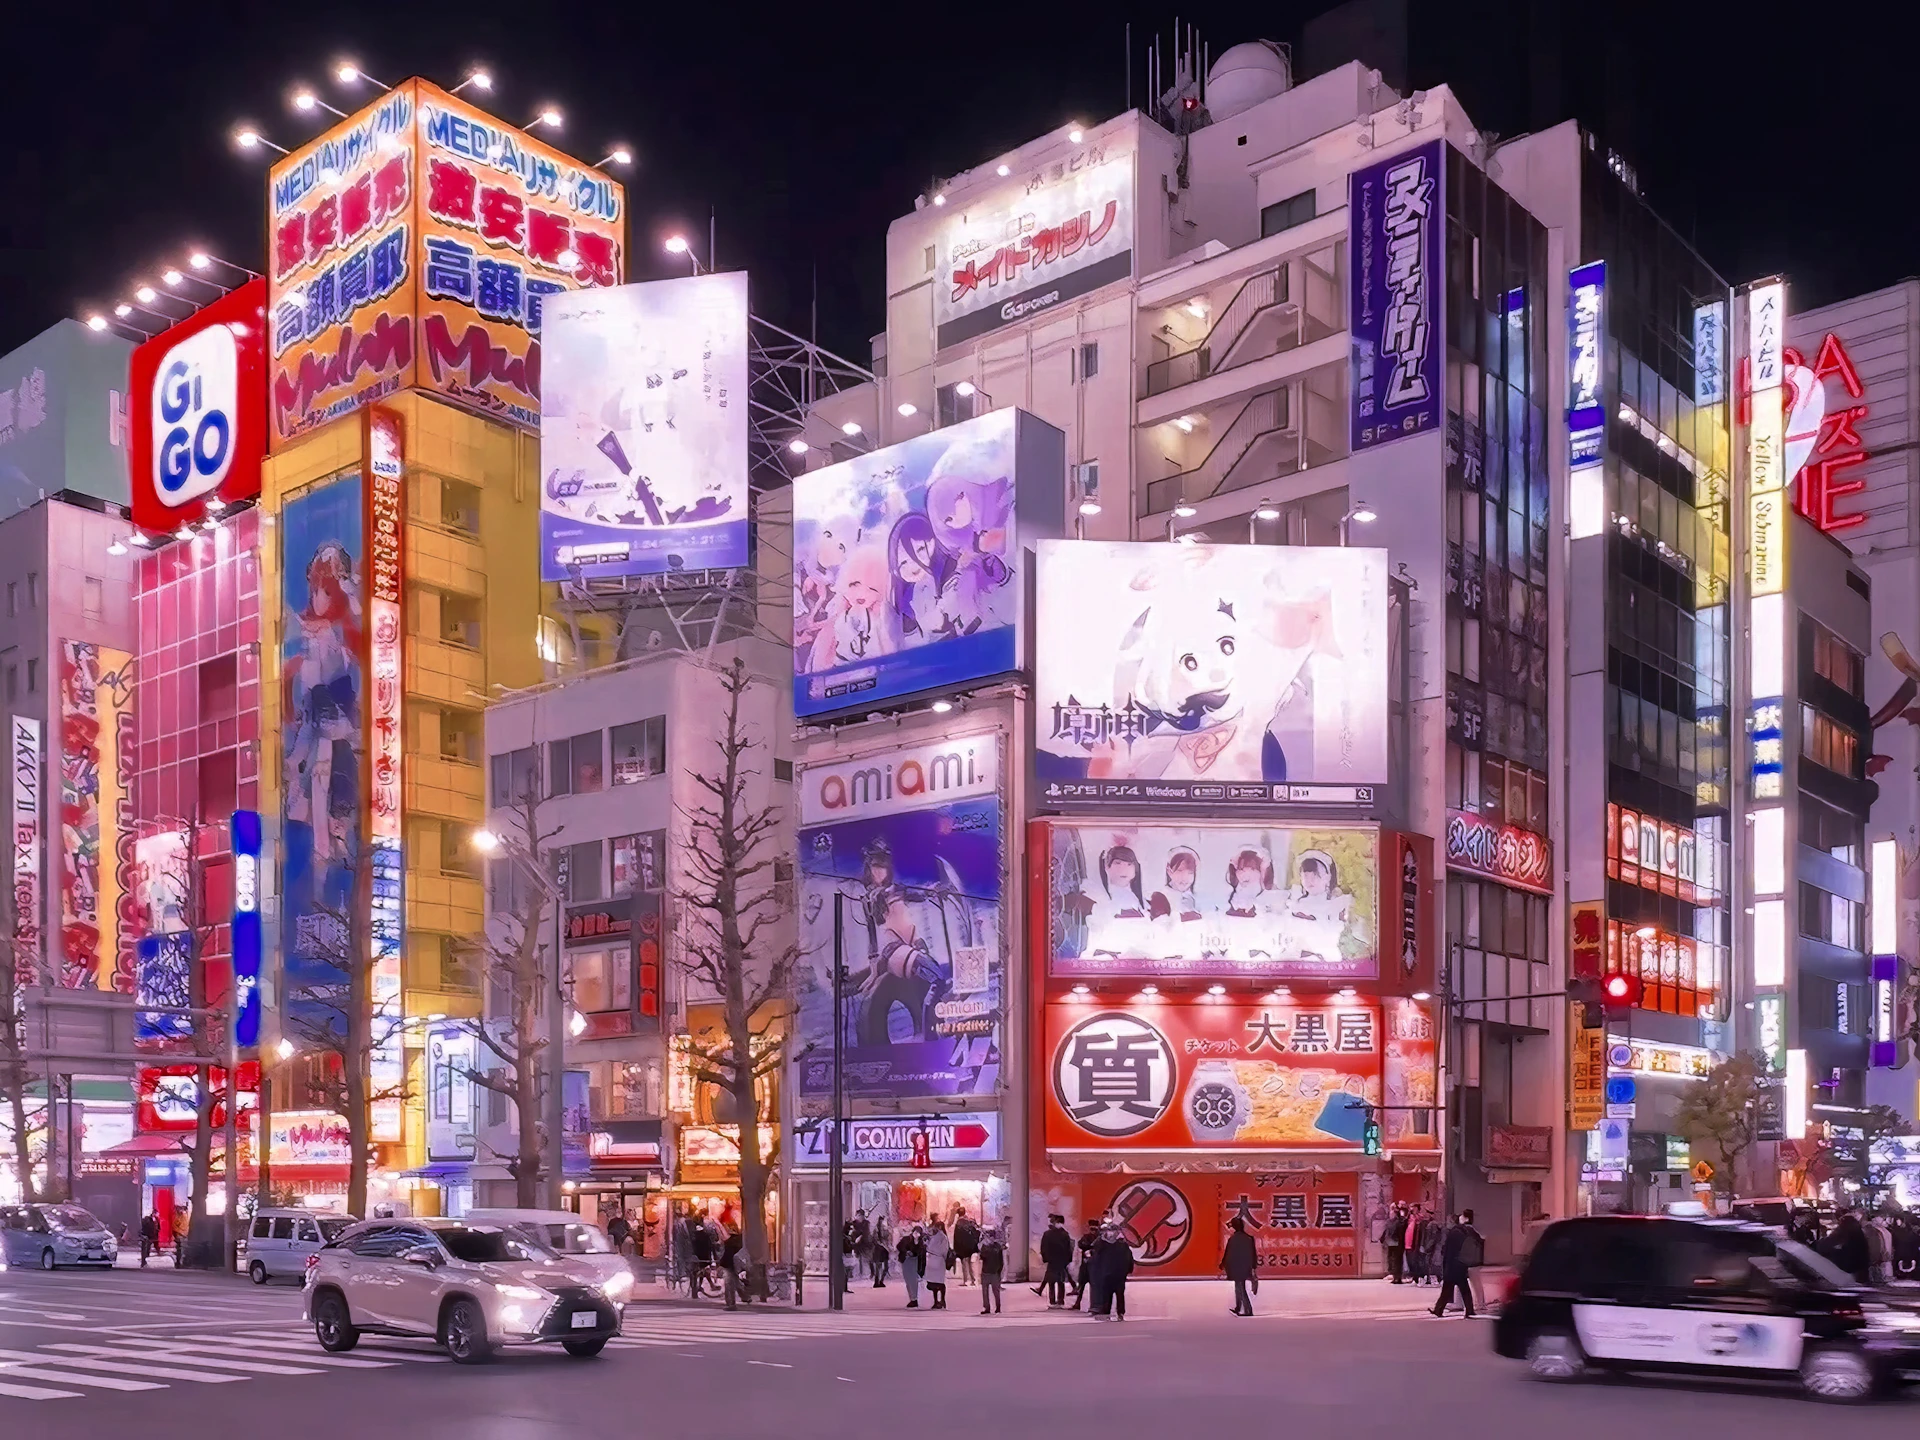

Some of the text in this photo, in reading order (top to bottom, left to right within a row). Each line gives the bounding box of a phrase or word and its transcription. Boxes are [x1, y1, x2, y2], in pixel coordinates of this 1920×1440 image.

[160, 409, 229, 492] GO
[820, 748, 975, 810] amiami
[1063, 784, 1098, 796] PS5
[1105, 784, 1142, 797] PS4
[1145, 785, 1188, 798] Windows
[1185, 1037, 1239, 1054] チケット
[1247, 1012, 1374, 1052] 大黒屋
[1069, 1031, 1161, 1120] 質
[1255, 1172, 1323, 1188] チケット
[1225, 1194, 1353, 1229] 大黒屋
